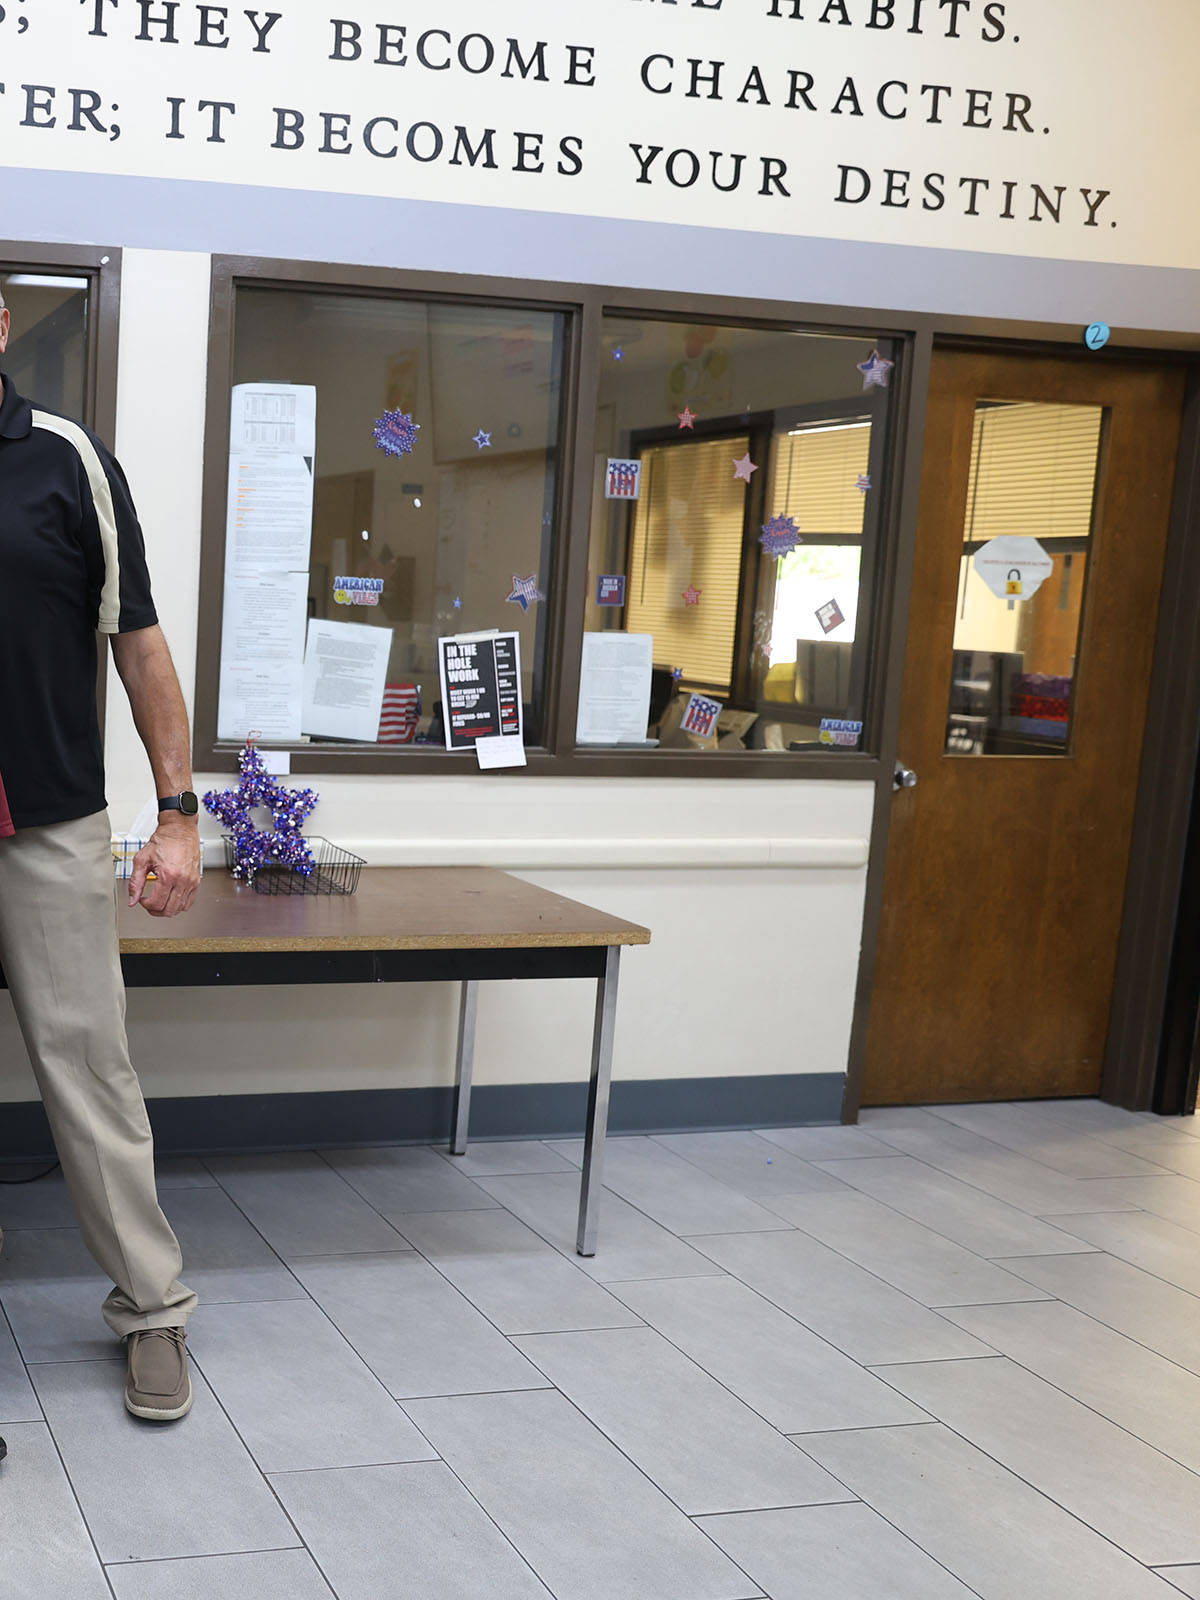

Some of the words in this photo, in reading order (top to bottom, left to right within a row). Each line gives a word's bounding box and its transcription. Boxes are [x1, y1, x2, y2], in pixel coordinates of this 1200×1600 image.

[81, 0, 282, 53] THEY
[328, 19, 596, 87] BECOME
[640, 54, 1050, 135] CHARACTER.
[166, 97, 235, 143] IT
[271, 107, 584, 176] BECOMES
[629, 143, 792, 198] YOUR
[834, 164, 1119, 229] DESTINY.
[1090, 324, 1105, 344] 2
[333, 576, 383, 592] AMERICAN
[446, 645, 458, 657] IN
[458, 644, 477, 656] THE
[447, 656, 472, 670] HOLE
[447, 669, 479, 682] WORK
